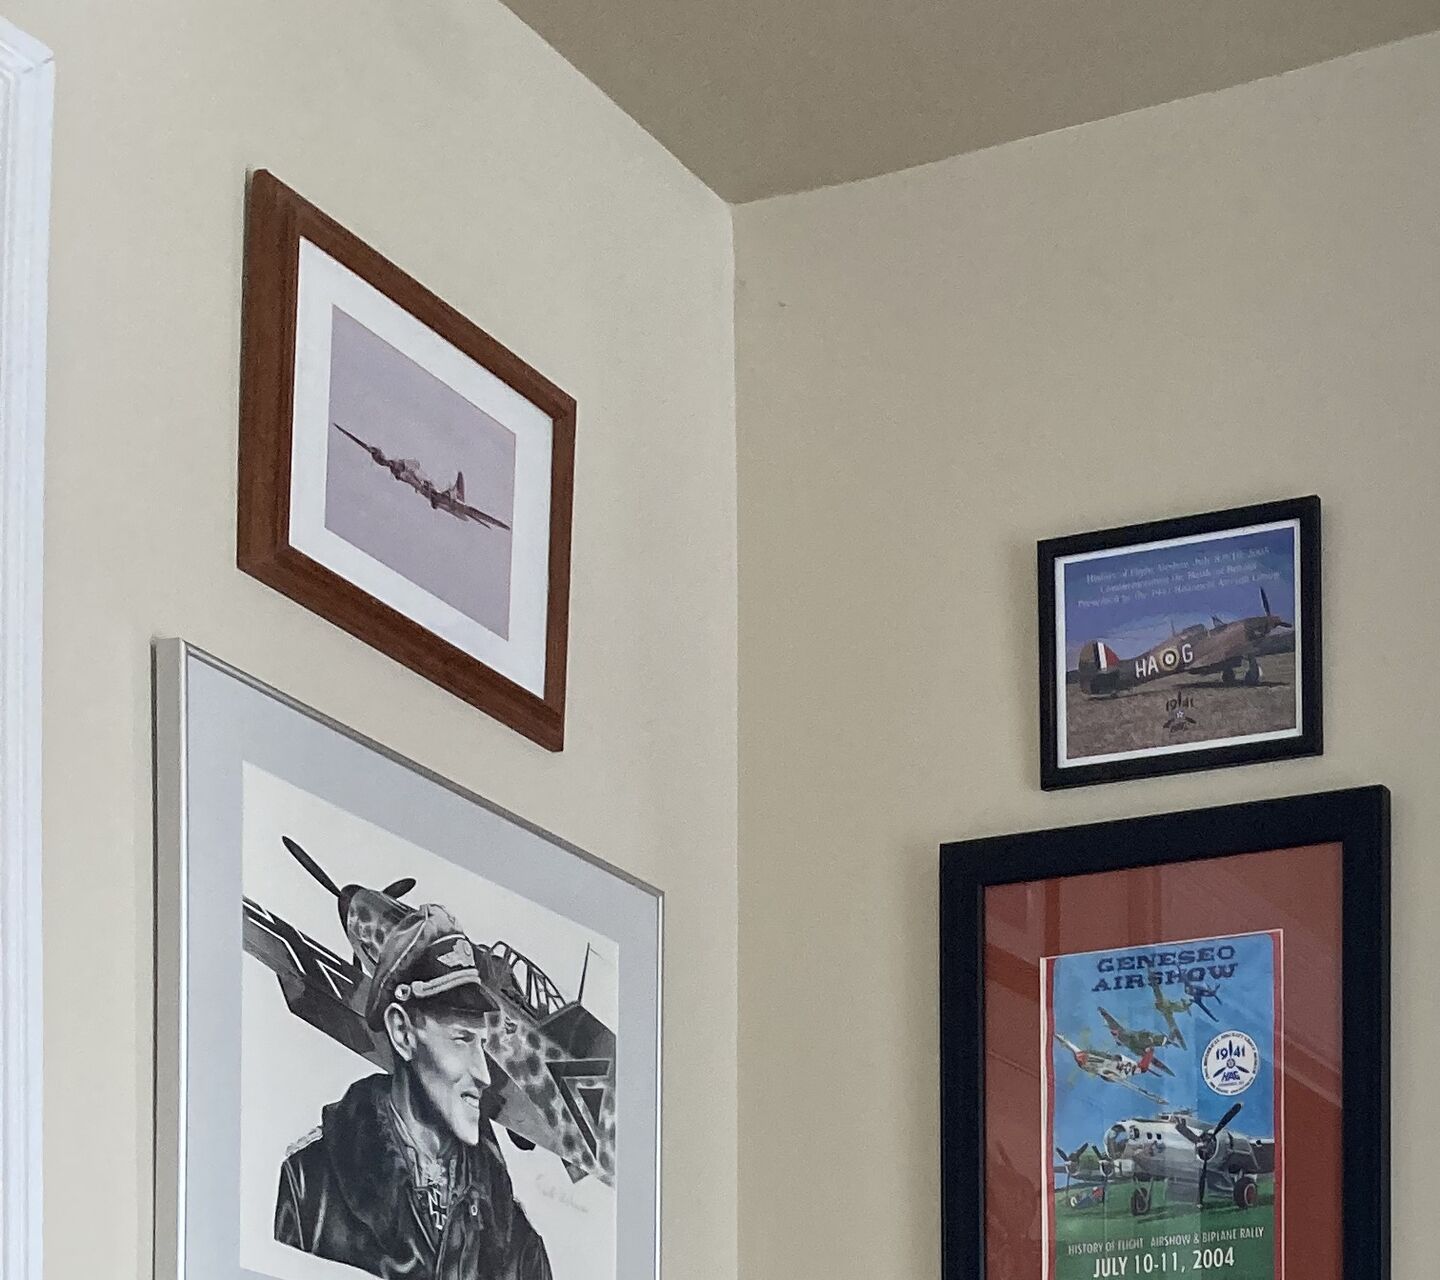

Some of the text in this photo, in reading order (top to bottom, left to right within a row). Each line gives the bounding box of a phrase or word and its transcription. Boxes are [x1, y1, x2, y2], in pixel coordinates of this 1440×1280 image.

[1097, 945, 1236, 973] GENESEO
[1092, 962, 1239, 992] AIRSHOW
[1068, 1242, 1103, 1255] HISTORY
[1117, 1238, 1144, 1250] FLIGHT
[1150, 1233, 1190, 1248] AIRSHOW
[1193, 1232, 1200, 1244] &
[1202, 1228, 1238, 1244] BIPLANE
[1239, 1226, 1265, 1239] RALLY
[1093, 1246, 1235, 1278] JULY 10-11, 2004
